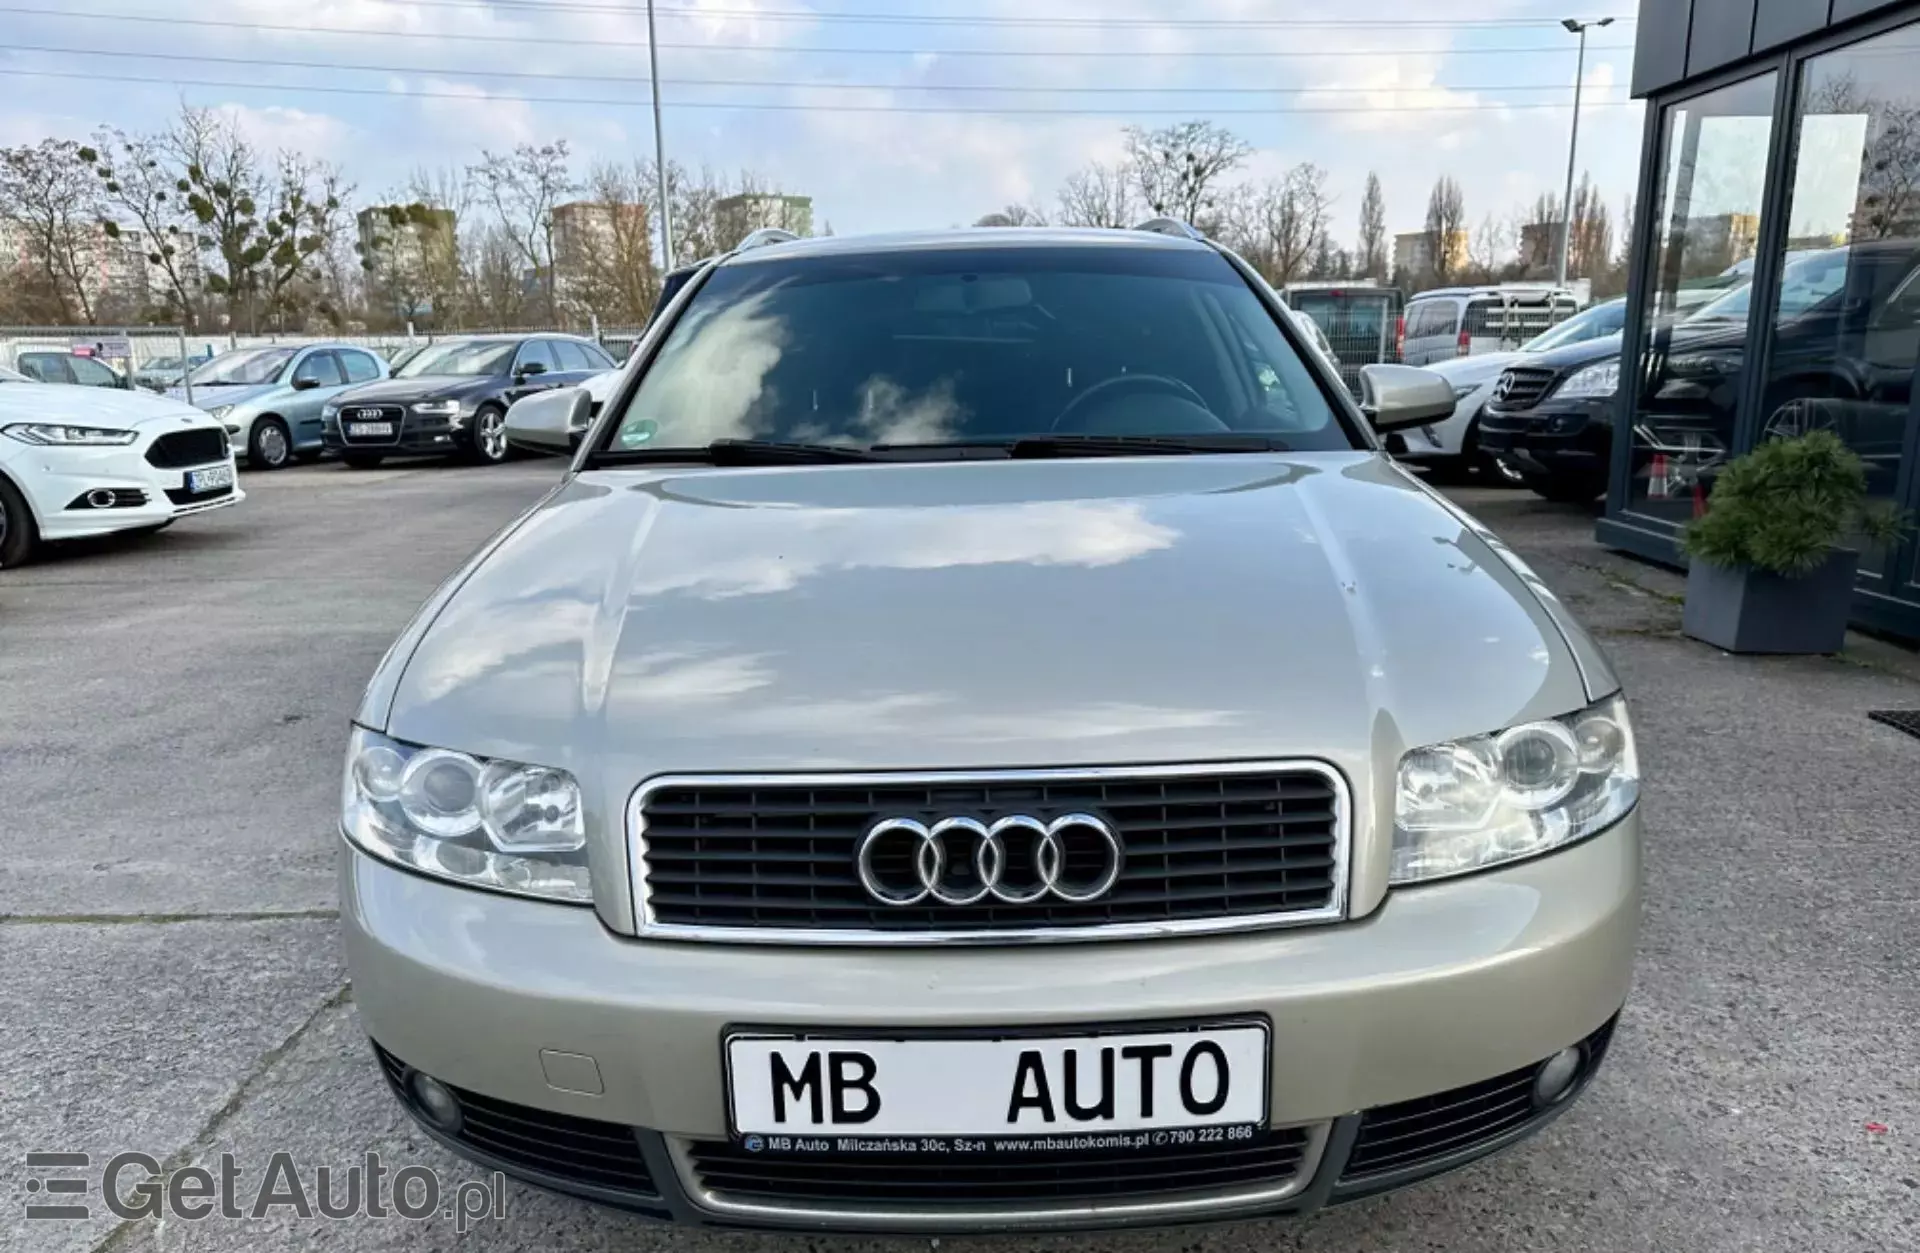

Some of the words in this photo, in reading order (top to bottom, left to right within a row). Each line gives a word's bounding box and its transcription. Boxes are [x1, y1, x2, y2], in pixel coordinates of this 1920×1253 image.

[770, 1051, 881, 1124] MB
[1007, 1040, 1230, 1123] AUTO
[768, 1137, 792, 1150] MB
[795, 1138, 829, 1150] Auto
[837, 1137, 917, 1151] Milczańska
[921, 1138, 950, 1152] 30c,
[954, 1138, 986, 1150] Sz-n
[994, 1134, 1149, 1151] www.mbautokomis.pl
[1170, 1130, 1193, 1144] 790
[1198, 1128, 1223, 1142] 222
[1228, 1125, 1252, 1139] 866
